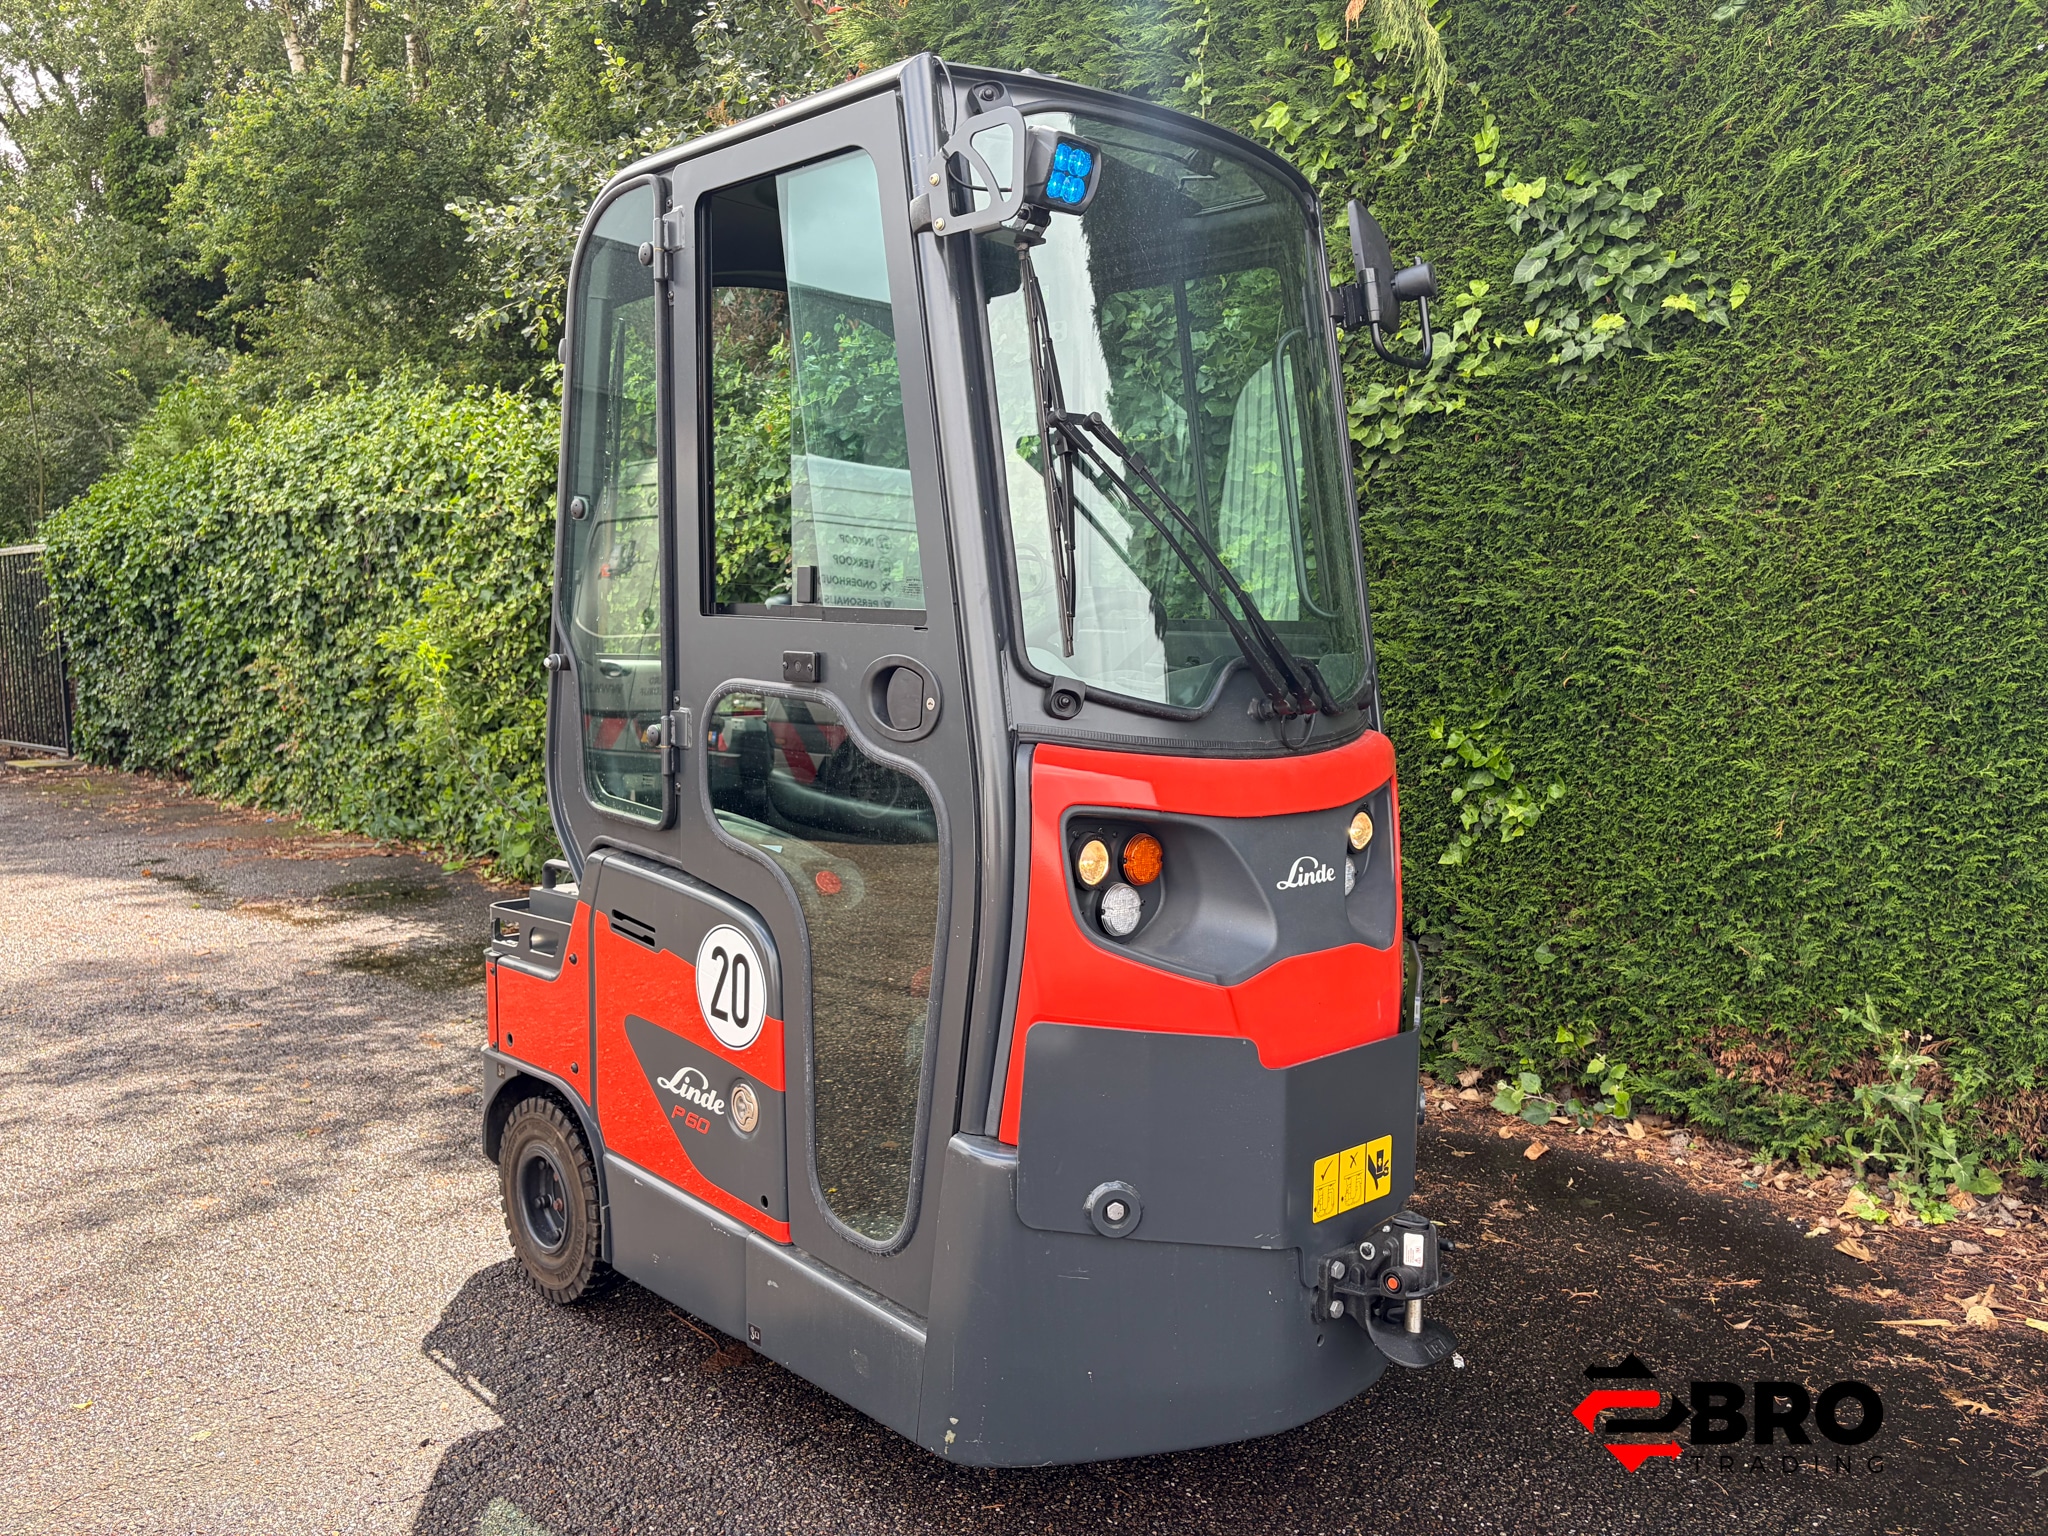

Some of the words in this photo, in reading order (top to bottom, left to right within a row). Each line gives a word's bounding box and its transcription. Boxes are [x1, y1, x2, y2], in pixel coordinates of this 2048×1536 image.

[1276, 856, 1336, 890] Linde
[710, 945, 750, 1029] 20
[657, 1067, 725, 1115] Linde
[671, 1104, 686, 1119] P
[685, 1113, 711, 1135] 60
